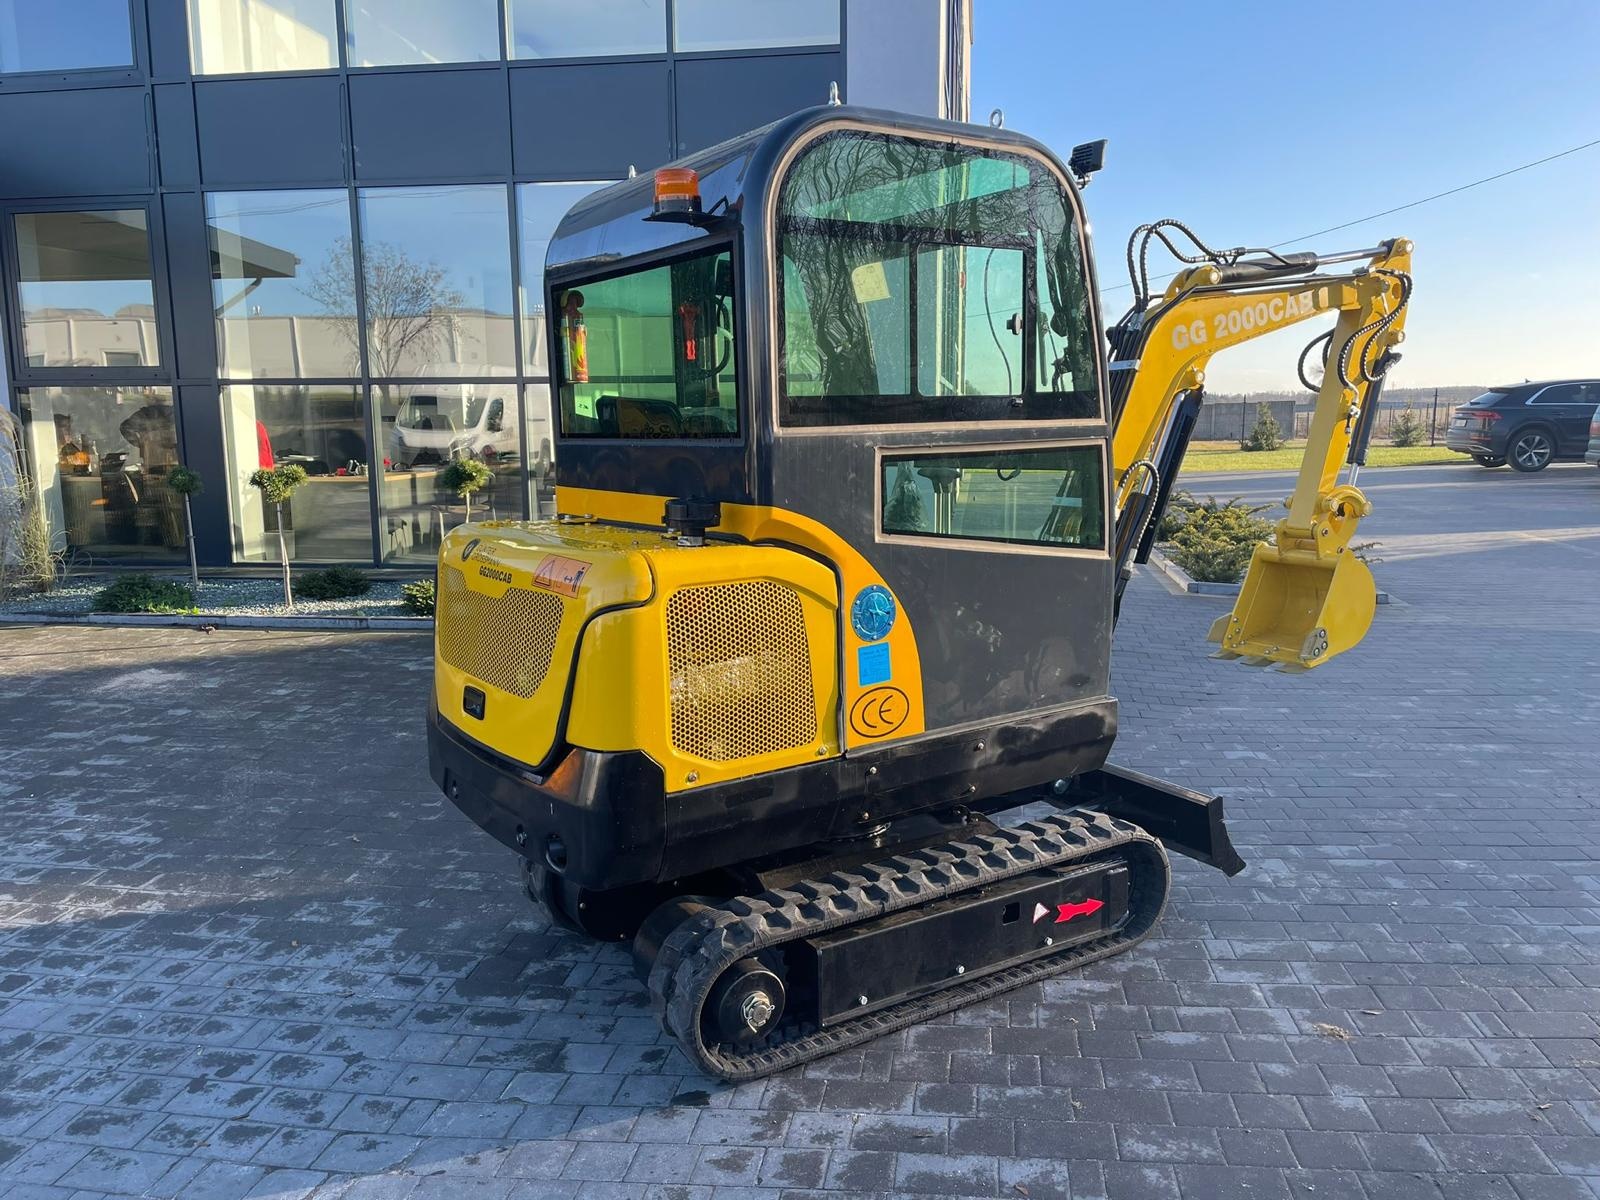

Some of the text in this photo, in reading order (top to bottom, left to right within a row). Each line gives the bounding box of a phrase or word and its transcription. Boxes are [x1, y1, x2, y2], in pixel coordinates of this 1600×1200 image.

[1173, 290, 1314, 350] GG 2000CAB
[479, 565, 513, 584] GG2000CAB
[862, 694, 894, 728] CE
